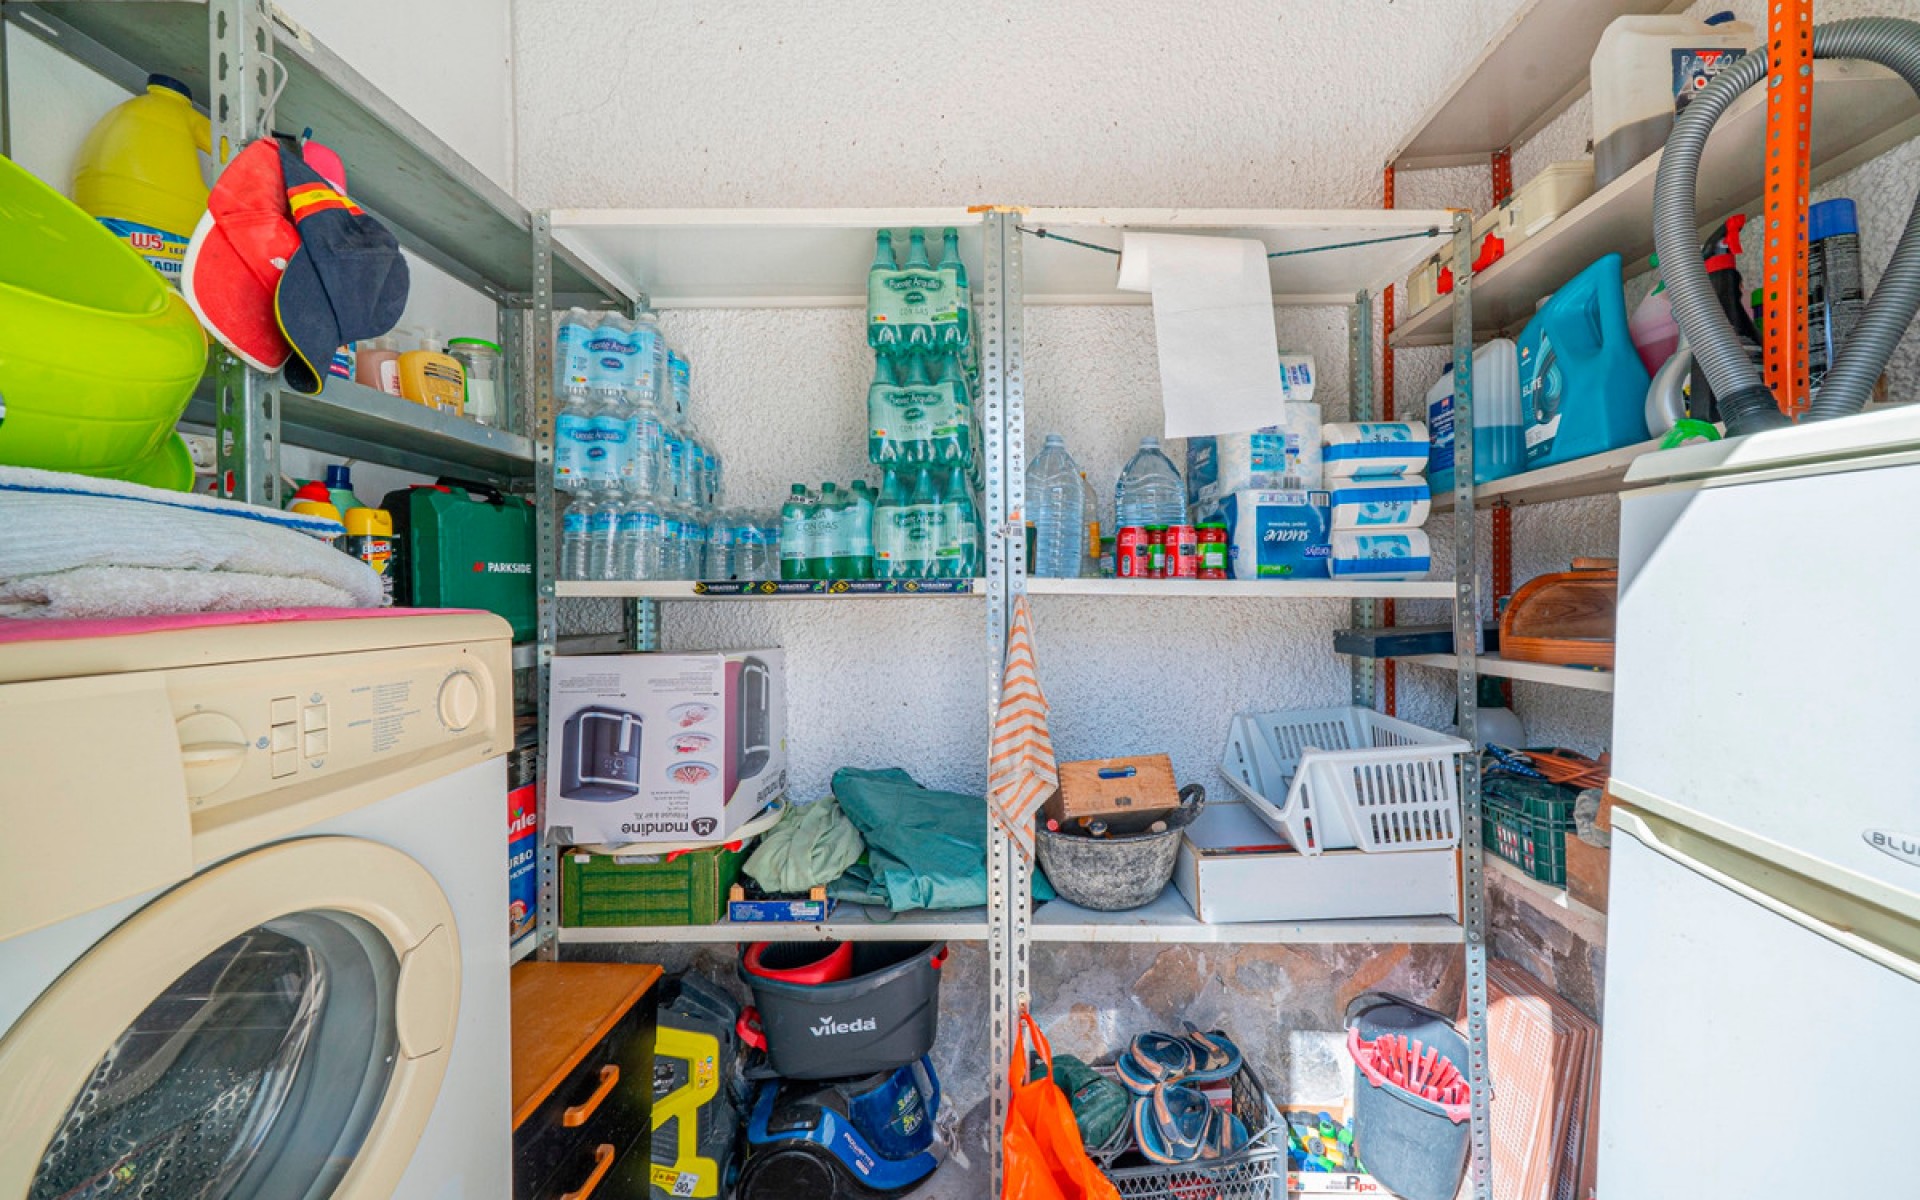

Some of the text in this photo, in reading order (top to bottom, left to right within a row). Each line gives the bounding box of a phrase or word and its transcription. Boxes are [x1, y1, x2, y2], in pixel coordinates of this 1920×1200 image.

[130, 231, 164, 251] W5
[1263, 528, 1311, 543] suave
[487, 561, 533, 574] PARKSIDE
[621, 822, 689, 838] mandine
[1873, 832, 1920, 856] BLU
[809, 1015, 877, 1037] vileda
